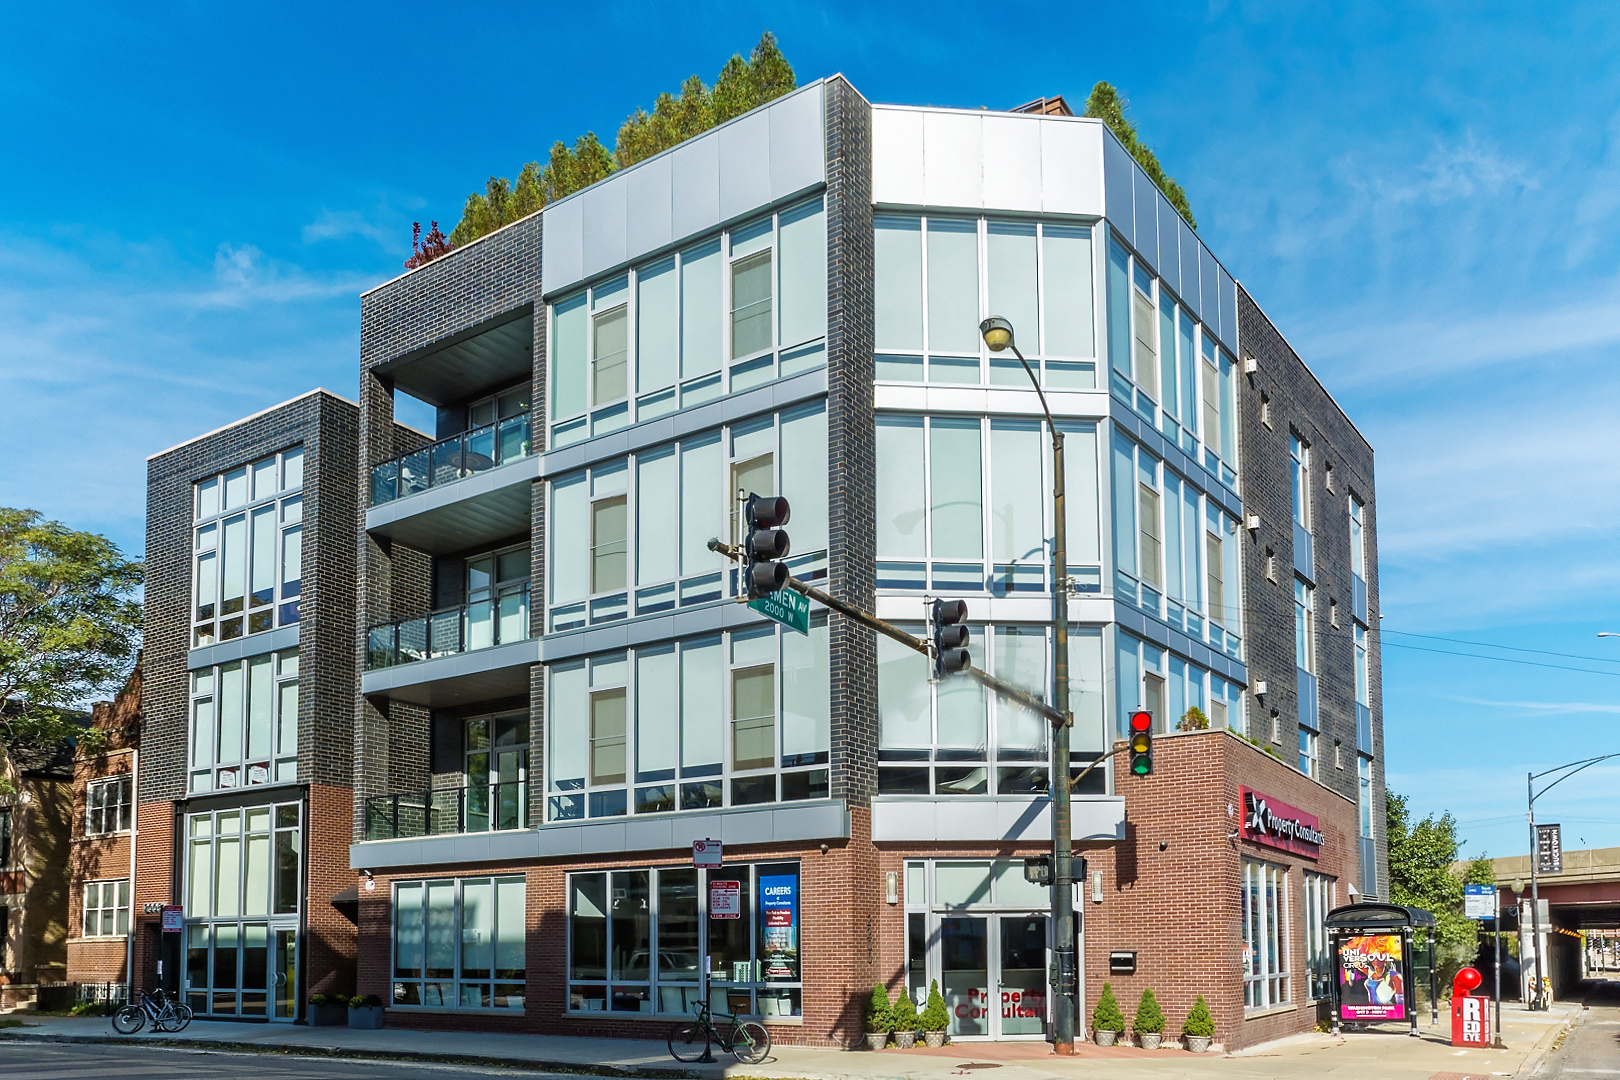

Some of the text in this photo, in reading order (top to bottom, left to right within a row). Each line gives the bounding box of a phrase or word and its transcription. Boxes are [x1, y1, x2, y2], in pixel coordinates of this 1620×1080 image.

[764, 600, 794, 622] 2000 W
[798, 601, 807, 613] AV
[1267, 807, 1325, 846] Property Consultants
[1552, 829, 1560, 866] BUCKTOWN
[765, 886, 792, 896] CAREERS
[967, 987, 1047, 1004] Prperty
